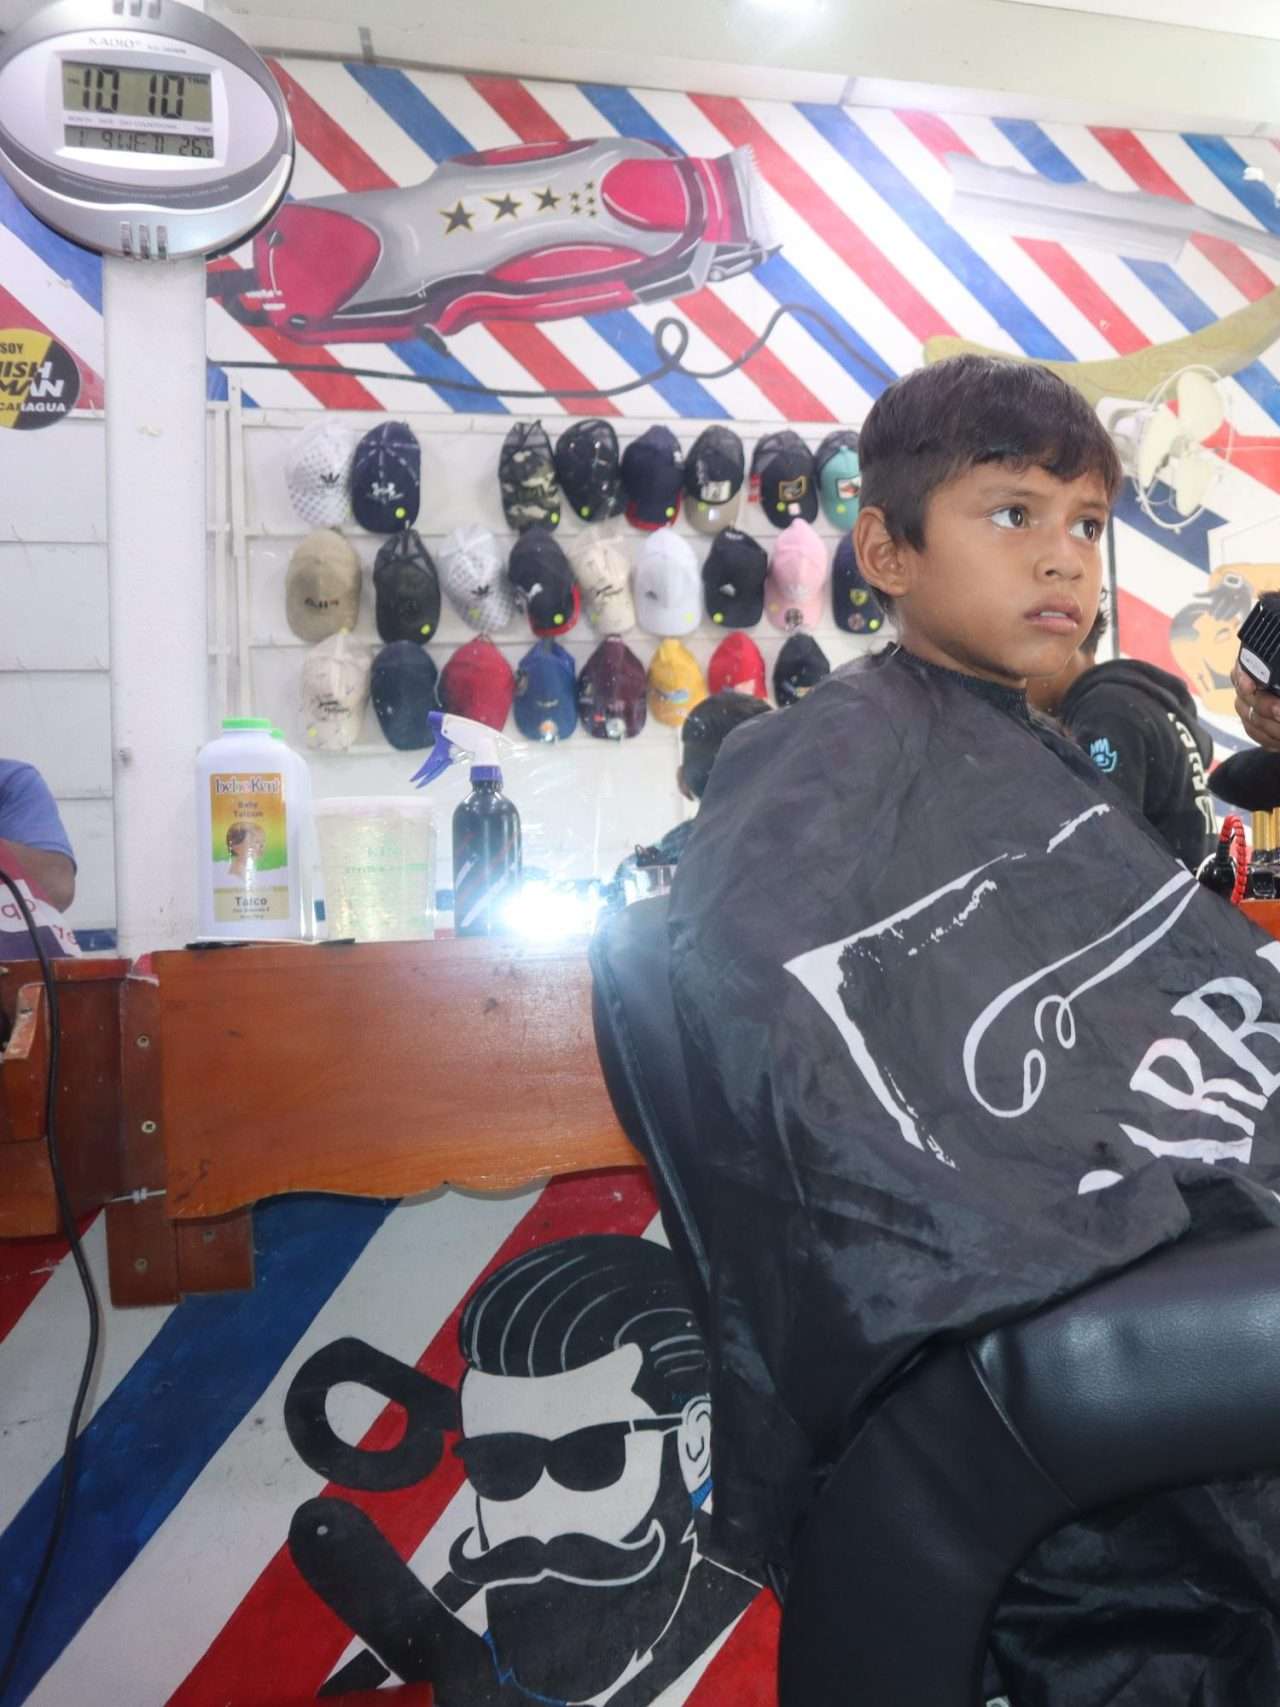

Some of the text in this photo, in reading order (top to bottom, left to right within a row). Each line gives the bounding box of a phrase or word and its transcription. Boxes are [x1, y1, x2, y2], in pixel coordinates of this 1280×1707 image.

[83, 69, 184, 119] 10 10
[0, 361, 53, 378] ISH
